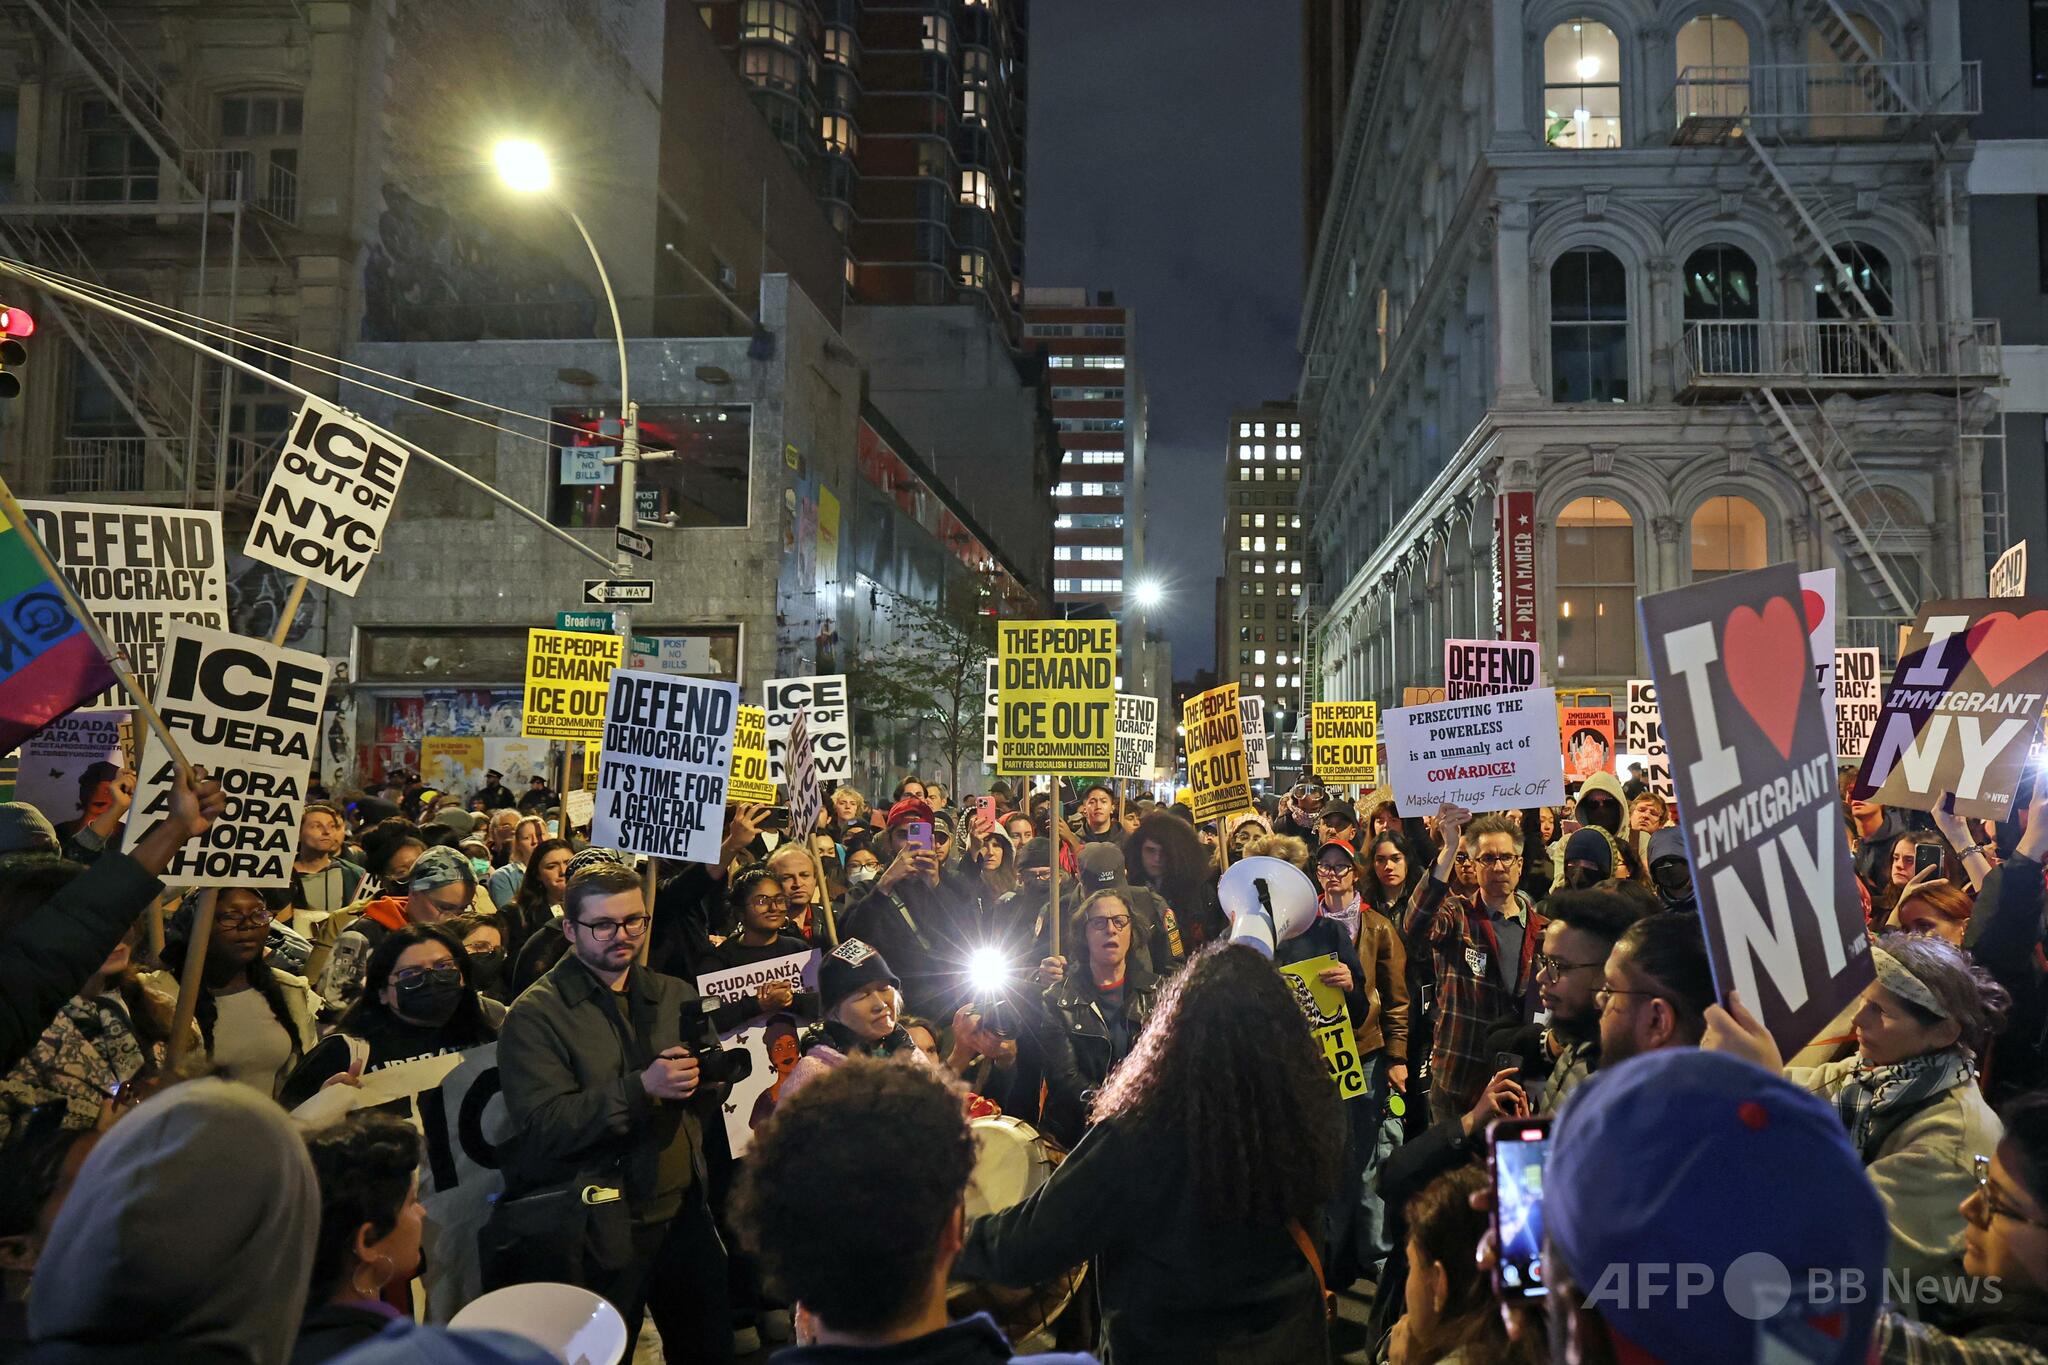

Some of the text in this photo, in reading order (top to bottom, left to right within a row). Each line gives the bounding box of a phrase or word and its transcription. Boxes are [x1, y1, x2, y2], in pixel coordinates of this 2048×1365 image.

[294, 408, 402, 494] ICE
[577, 451, 599, 459] POST
[283, 452, 390, 511] OUT OF
[635, 491, 658, 499] POST
[264, 484, 376, 554] NYC
[23, 509, 214, 568] DEFEND
[620, 533, 648, 550] ONE WAY
[253, 520, 364, 583] NOW
[66, 567, 217, 601] MOCRACY:
[597, 588, 645, 596] ONE WAY
[1516, 583, 1532, 591] A
[1516, 595, 1533, 622] PRET
[93, 612, 165, 643] TIME
[565, 615, 606, 630] Broadway
[534, 635, 619, 658] THE PEOPLE
[664, 640, 686, 648] POST
[1004, 628, 1111, 654] THE PEOPLE
[1903, 615, 1970, 686] I
[532, 656, 616, 682] DEMAND
[662, 660, 687, 668] BILLS
[1005, 658, 1111, 689] DEMAND
[1450, 645, 1534, 685] DEFEND
[1835, 652, 1874, 680] END
[167, 636, 323, 725] ICE
[1448, 681, 1529, 701] DEMOCR
[1835, 681, 1876, 698] RACY:
[529, 687, 565, 714] ICE
[611, 676, 732, 736] DEFEND
[767, 681, 844, 711] ICE
[1631, 685, 1657, 702] IC
[1886, 689, 2041, 714] IMMIGRANT
[814, 709, 844, 723] OF
[1004, 702, 1046, 739] ICE
[1052, 701, 1109, 739] OUT
[1115, 697, 1155, 721] FEND
[1185, 702, 1198, 726] THE
[1199, 689, 1235, 720] PEOPLE
[1315, 706, 1373, 719] THE PEOPLE
[1409, 699, 1523, 725] PERSECUTING THE
[1663, 621, 1742, 806] I
[1851, 704, 1877, 721] FOR
[155, 708, 309, 760] FUERA
[527, 715, 604, 728] OF OUR COMMUNITIE
[744, 713, 765, 730] PEO
[1116, 720, 1154, 736] OCRACY:
[1188, 714, 1239, 754] DEMAND
[1316, 721, 1373, 738] DEMAND
[1430, 721, 1503, 741] POWERLESS
[1836, 722, 1869, 738] ERAL
[87, 733, 119, 744] TOD
[606, 723, 725, 767] DEMOCRACY:
[1003, 742, 1109, 757] OF OUR COMMUNITIES!
[1115, 737, 1153, 753] TIME FOR
[1246, 738, 1264, 751] FOR
[1410, 736, 1530, 761] is an unmanly act of
[1836, 739, 1860, 755] IKE!
[771, 755, 847, 777] NW
[1035, 761, 1067, 769] SOCIALISM
[1073, 761, 1108, 769] LIBERATION
[1115, 750, 1147, 765] ENERAL
[1316, 745, 1373, 764] ICE OUT
[1867, 712, 2028, 800] NY
[744, 757, 767, 781] OU
[1114, 763, 1141, 777] TRIKE!
[1191, 761, 1209, 793] ICE
[1210, 750, 1241, 787] OUT
[1427, 762, 1516, 782] COWARDICE!
[602, 761, 723, 805] IT'S TIME FOR
[1406, 792, 1445, 806] Masked
[1451, 789, 1485, 805] Thugs
[1492, 783, 1521, 797] Fuck
[1524, 779, 1550, 799] Off
[141, 790, 295, 826] AORA
[1991, 793, 2008, 803] NYIC
[609, 791, 621, 819] A
[625, 793, 705, 831] GENERAL
[1693, 753, 1830, 869] IMMIGRANT
[618, 820, 691, 857] STRIKE!
[158, 851, 284, 878] HORA
[1712, 801, 1847, 1027] NY
[706, 961, 800, 995] CIUDADANÍA
